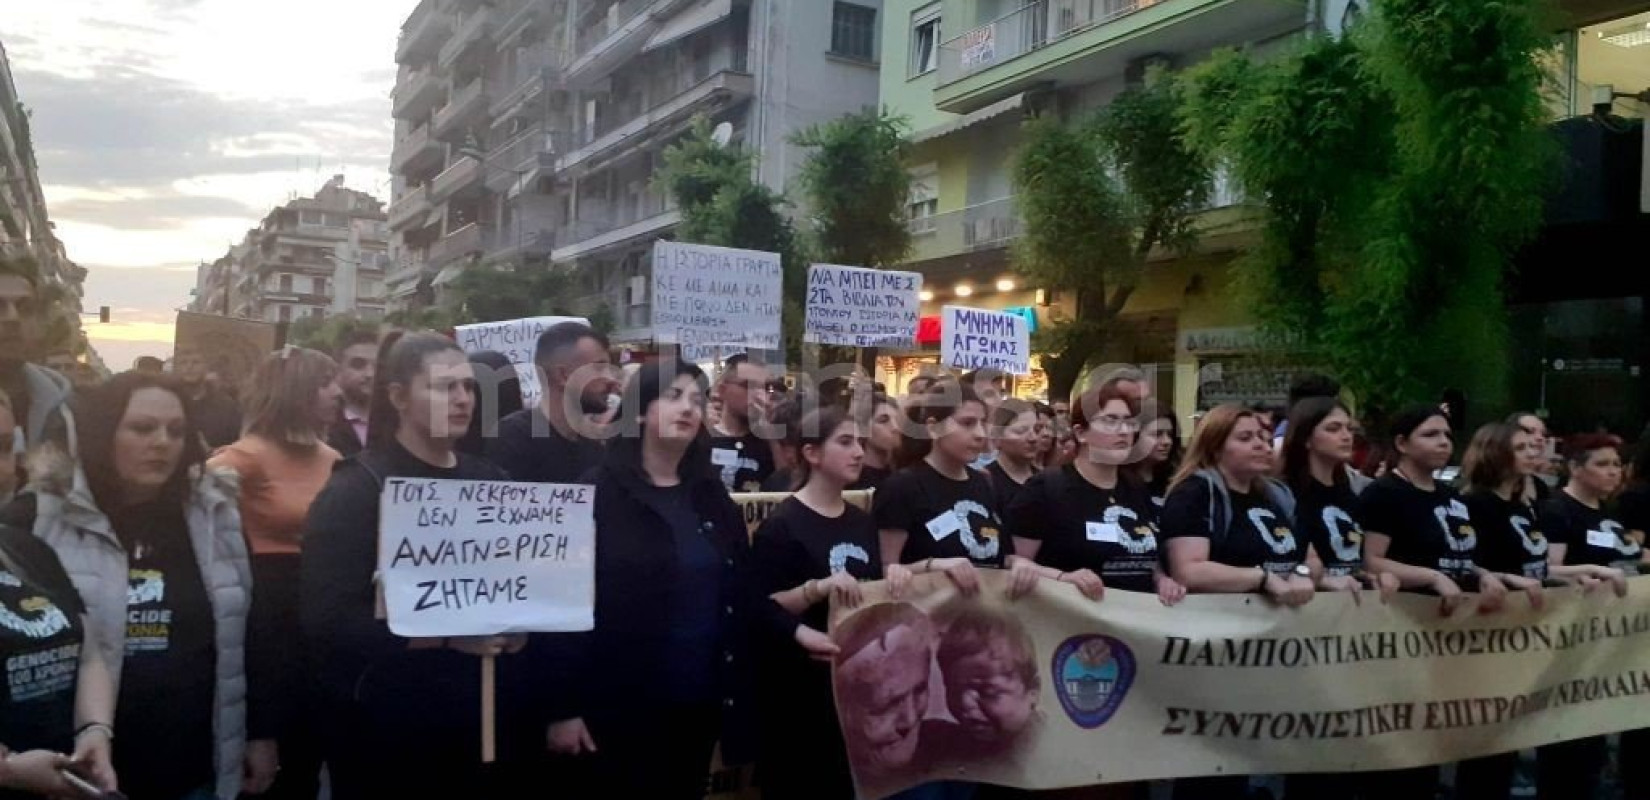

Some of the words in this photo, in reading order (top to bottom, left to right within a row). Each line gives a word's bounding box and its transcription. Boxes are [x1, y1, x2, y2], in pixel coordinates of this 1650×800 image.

[674, 248, 730, 271] ΙΣΤΟΡΙΑ
[810, 268, 835, 286] ΝΑ
[838, 270, 876, 290] ΜΠΕΙ
[954, 309, 1014, 337] ΜΝΗΜΗ
[952, 333, 1018, 356] ΑΓΩΝΑΣ
[389, 480, 441, 504] ΤΟΥΣ
[458, 483, 538, 504] ΝΕΚΡΟΥΣ
[548, 488, 588, 504] ΜΑΣ
[416, 507, 458, 527] ΔΕΝ
[476, 506, 564, 525] ΞΕΧΝΑΜΕ
[390, 533, 568, 568] ΑΝΑΓΝΩΡΙΣΗ
[413, 576, 528, 611] ΖΗΤΑΜΕ
[1160, 631, 1398, 668] ΠΑΜΠΟΝΤΙΑΚΗ
[1162, 702, 1414, 741] ΣΥΝΤΟΝΙΣΤΙΚΗ
[1422, 688, 1552, 730] ΕΠΙΤΡΟ
